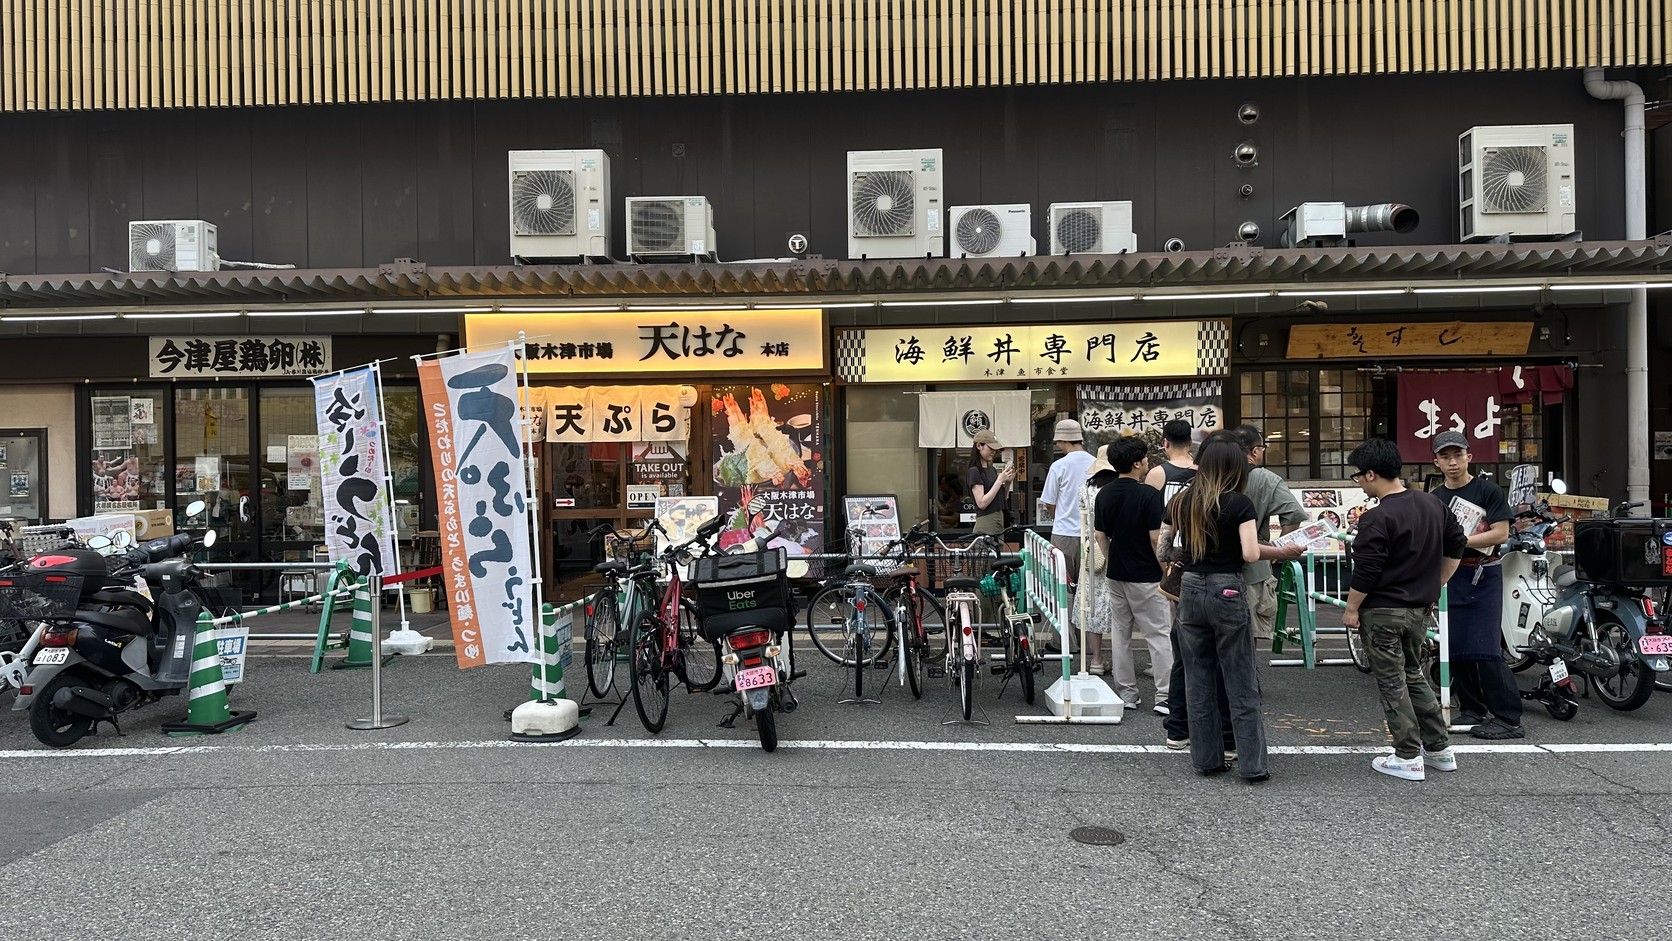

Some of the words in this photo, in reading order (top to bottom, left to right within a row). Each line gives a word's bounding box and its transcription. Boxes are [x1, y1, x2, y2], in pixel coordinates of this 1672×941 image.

[514, 342, 613, 359] 阪木津市場
[637, 321, 746, 361] 天はな
[760, 342, 789, 357] 本店
[1386, 326, 1462, 346] すし
[895, 331, 1161, 366] 海鮮丼専門店
[983, 369, 1005, 377] 木津
[554, 402, 676, 436] 天ぷら
[1083, 407, 1217, 431] 海鮮丼専門店
[635, 463, 660, 472] TAKE
[662, 463, 684, 472] OUT
[629, 493, 658, 501] OPEN
[762, 490, 815, 500] 大阪木津市場
[763, 502, 815, 521] 天はな
[727, 590, 755, 600] Uber
[728, 600, 757, 611] Eats
[42, 653, 66, 662] 1083
[745, 672, 773, 688] 8633
